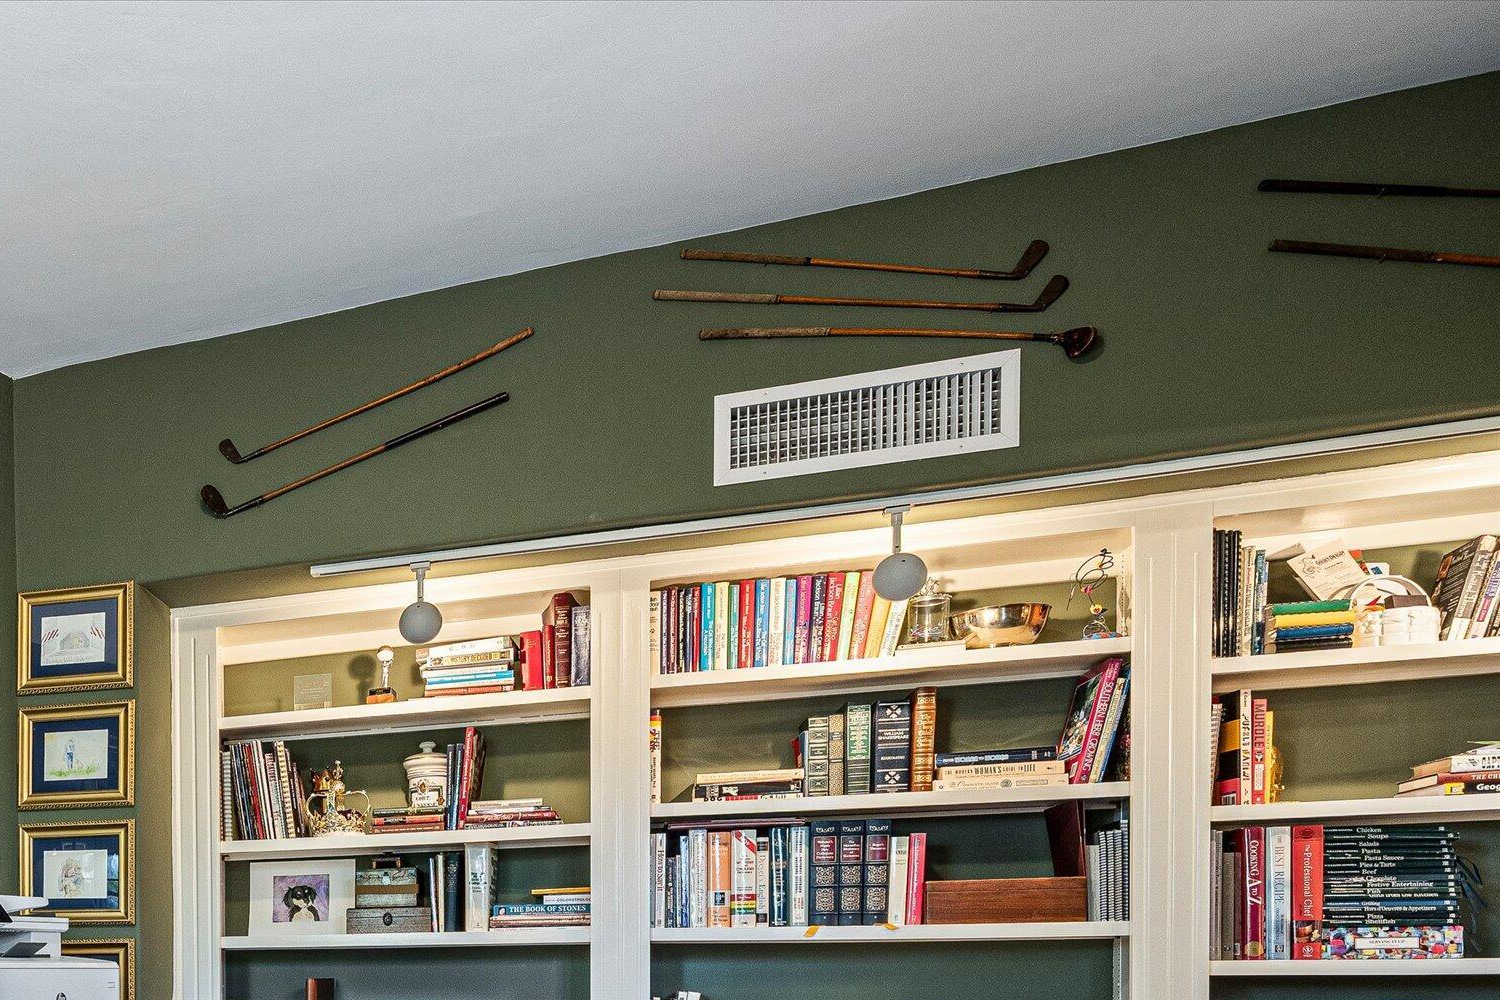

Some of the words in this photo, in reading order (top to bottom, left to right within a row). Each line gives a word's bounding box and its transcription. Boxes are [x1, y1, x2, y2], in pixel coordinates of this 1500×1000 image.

[829, 577, 837, 600] Jackson
[1098, 681, 1113, 718] SOUTHERN
[1091, 720, 1103, 736] HERB
[1254, 704, 1264, 747] MURDLE
[1024, 764, 1036, 772] LIFE
[1250, 840, 1259, 876] COOKING
[1274, 846, 1284, 867] BEST
[1248, 878, 1262, 887] A
[1303, 852, 1312, 896] Professional
[1274, 871, 1284, 904] RECIPE
[1248, 897, 1262, 905] Z
[1303, 900, 1313, 918] Chef
